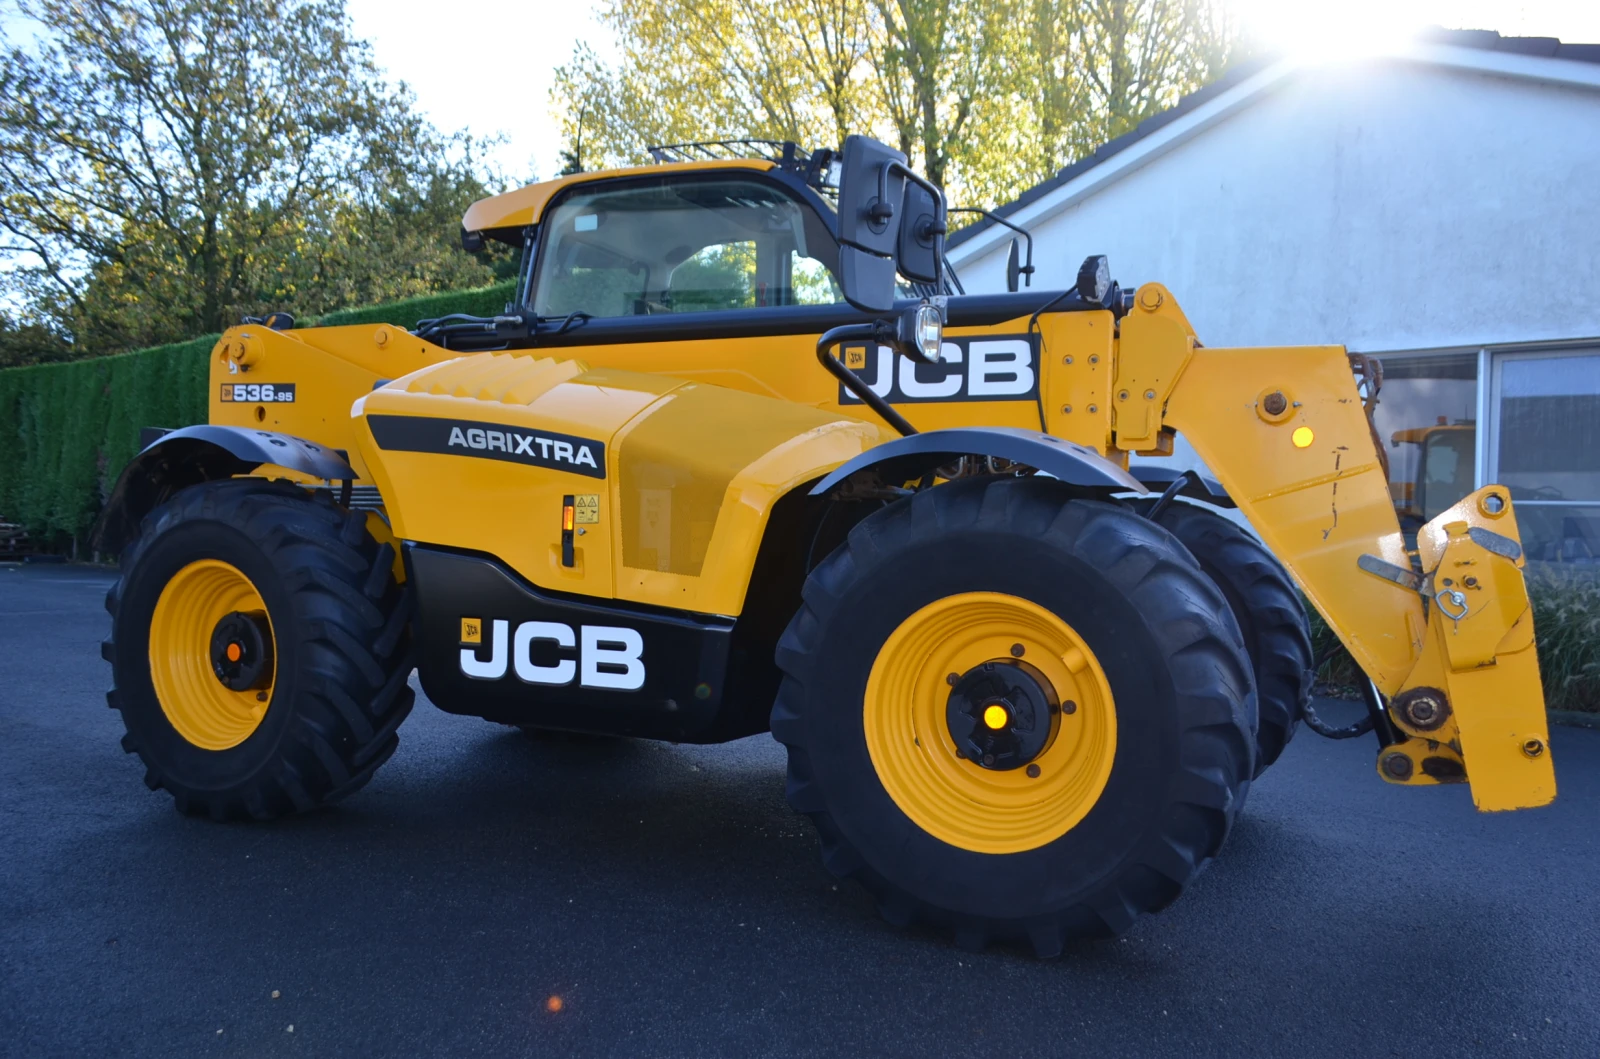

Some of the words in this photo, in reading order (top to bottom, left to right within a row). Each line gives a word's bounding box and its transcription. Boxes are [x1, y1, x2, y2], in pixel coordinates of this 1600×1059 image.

[845, 340, 1034, 399] JCB
[448, 427, 598, 469] AGRIXTRA
[460, 619, 646, 690] JCB
